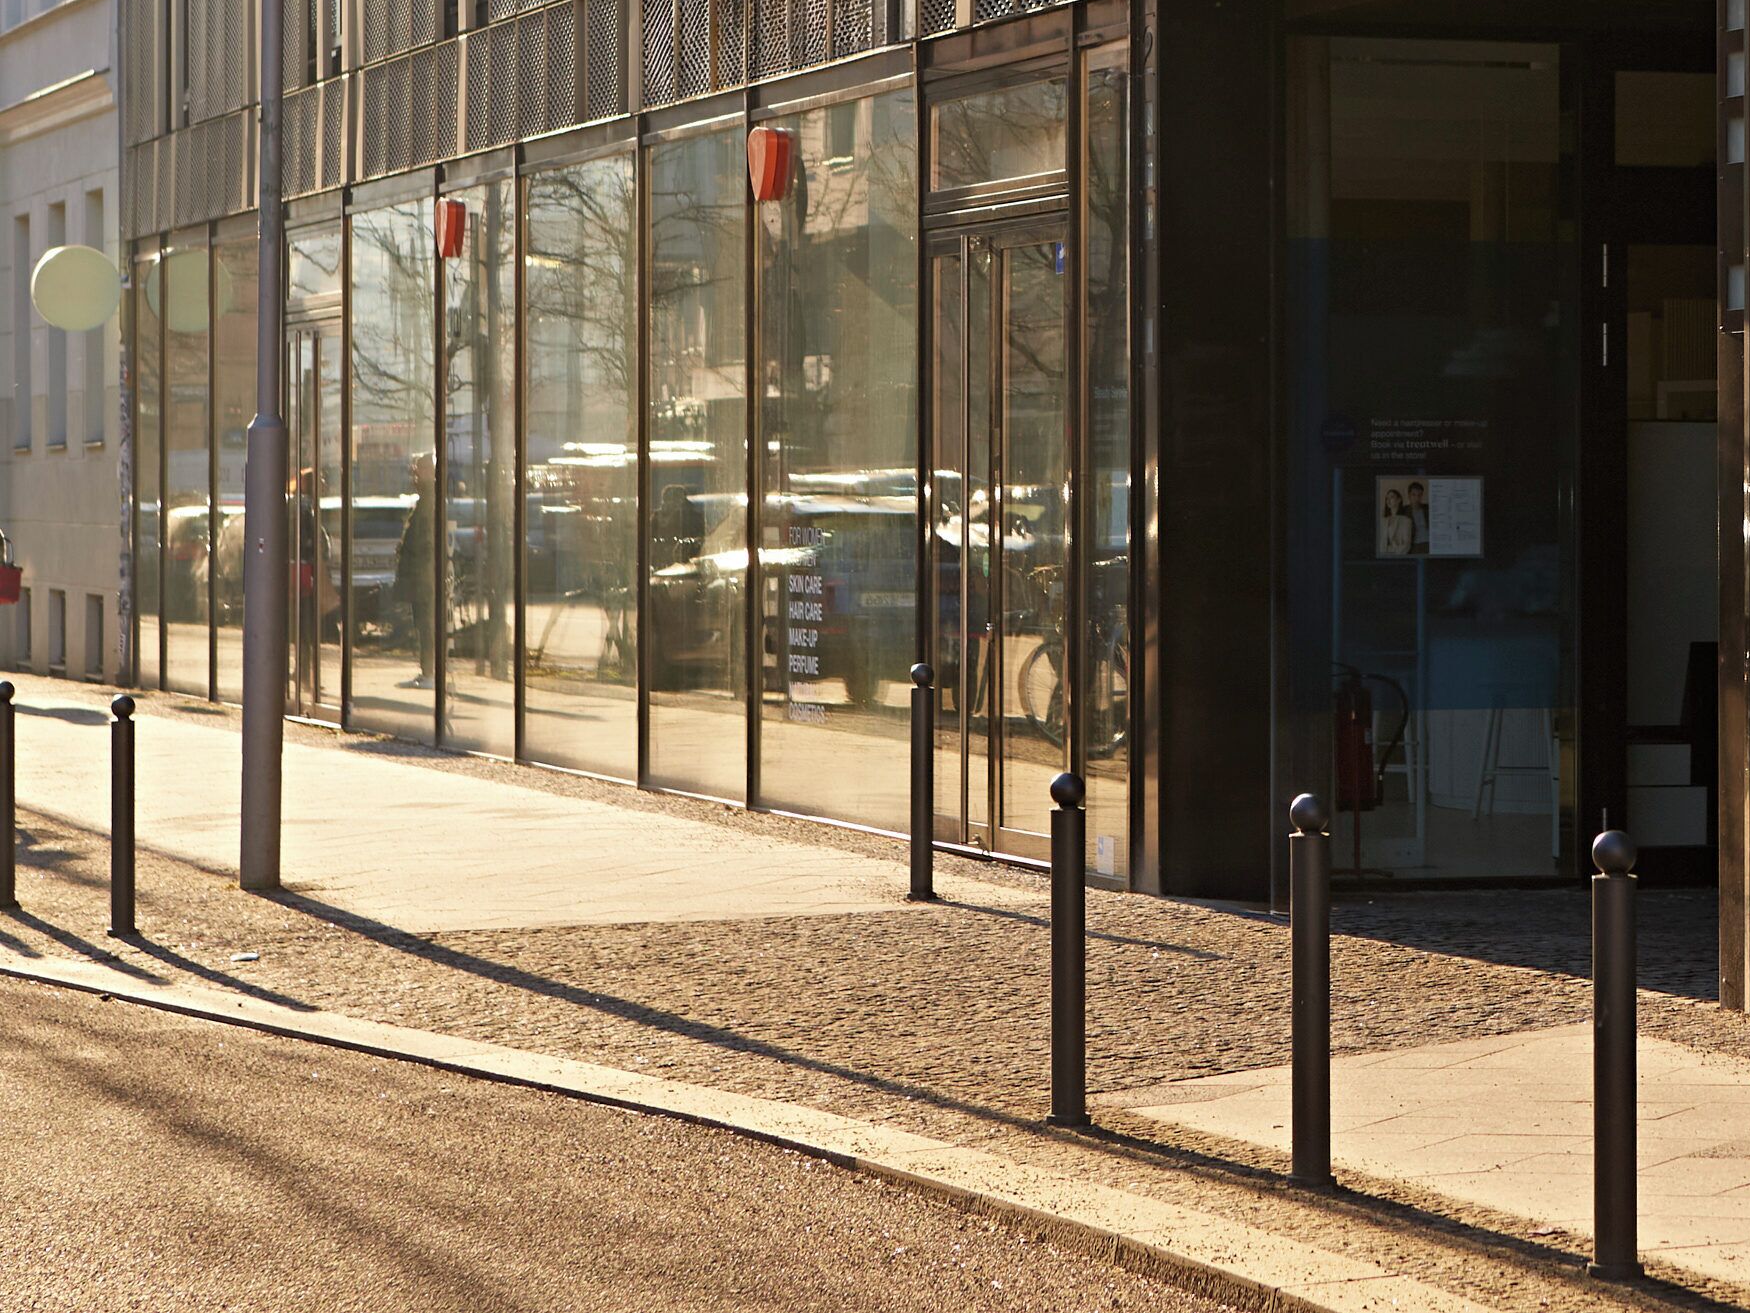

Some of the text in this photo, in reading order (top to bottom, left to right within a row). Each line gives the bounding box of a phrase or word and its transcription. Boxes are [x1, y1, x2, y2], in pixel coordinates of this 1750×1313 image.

[1406, 439, 1449, 448] treatwell
[789, 526, 826, 547] FOR WOMEN
[789, 574, 822, 595] SKIN CARE
[789, 601, 822, 621] HAIR CARE
[789, 628, 818, 648] MAKE-UP
[789, 654, 819, 675] PERFUME
[789, 702, 826, 724] COSMETICS
